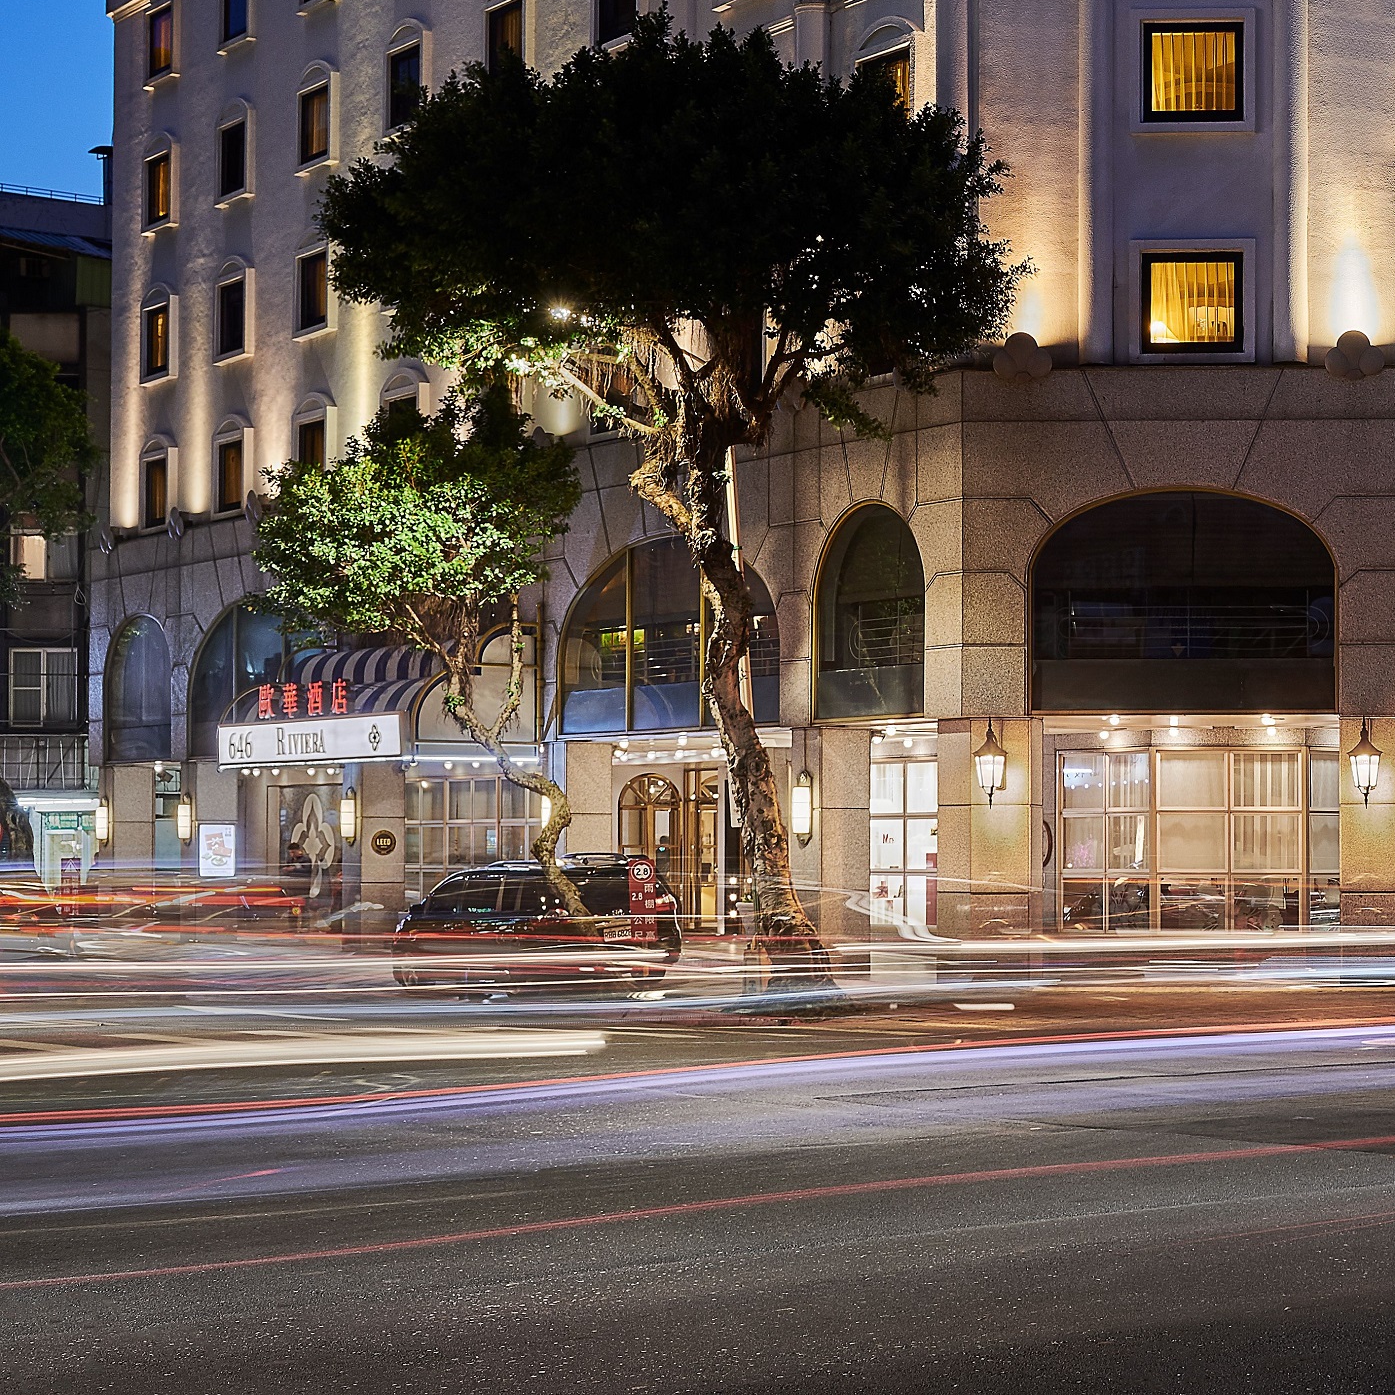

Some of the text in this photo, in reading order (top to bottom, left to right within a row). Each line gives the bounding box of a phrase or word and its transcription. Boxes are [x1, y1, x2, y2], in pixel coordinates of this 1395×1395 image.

[258, 678, 348, 719] 歐華酒店
[228, 730, 253, 760] 646
[376, 838, 391, 846] LEED
[635, 867, 649, 876] 2.8
